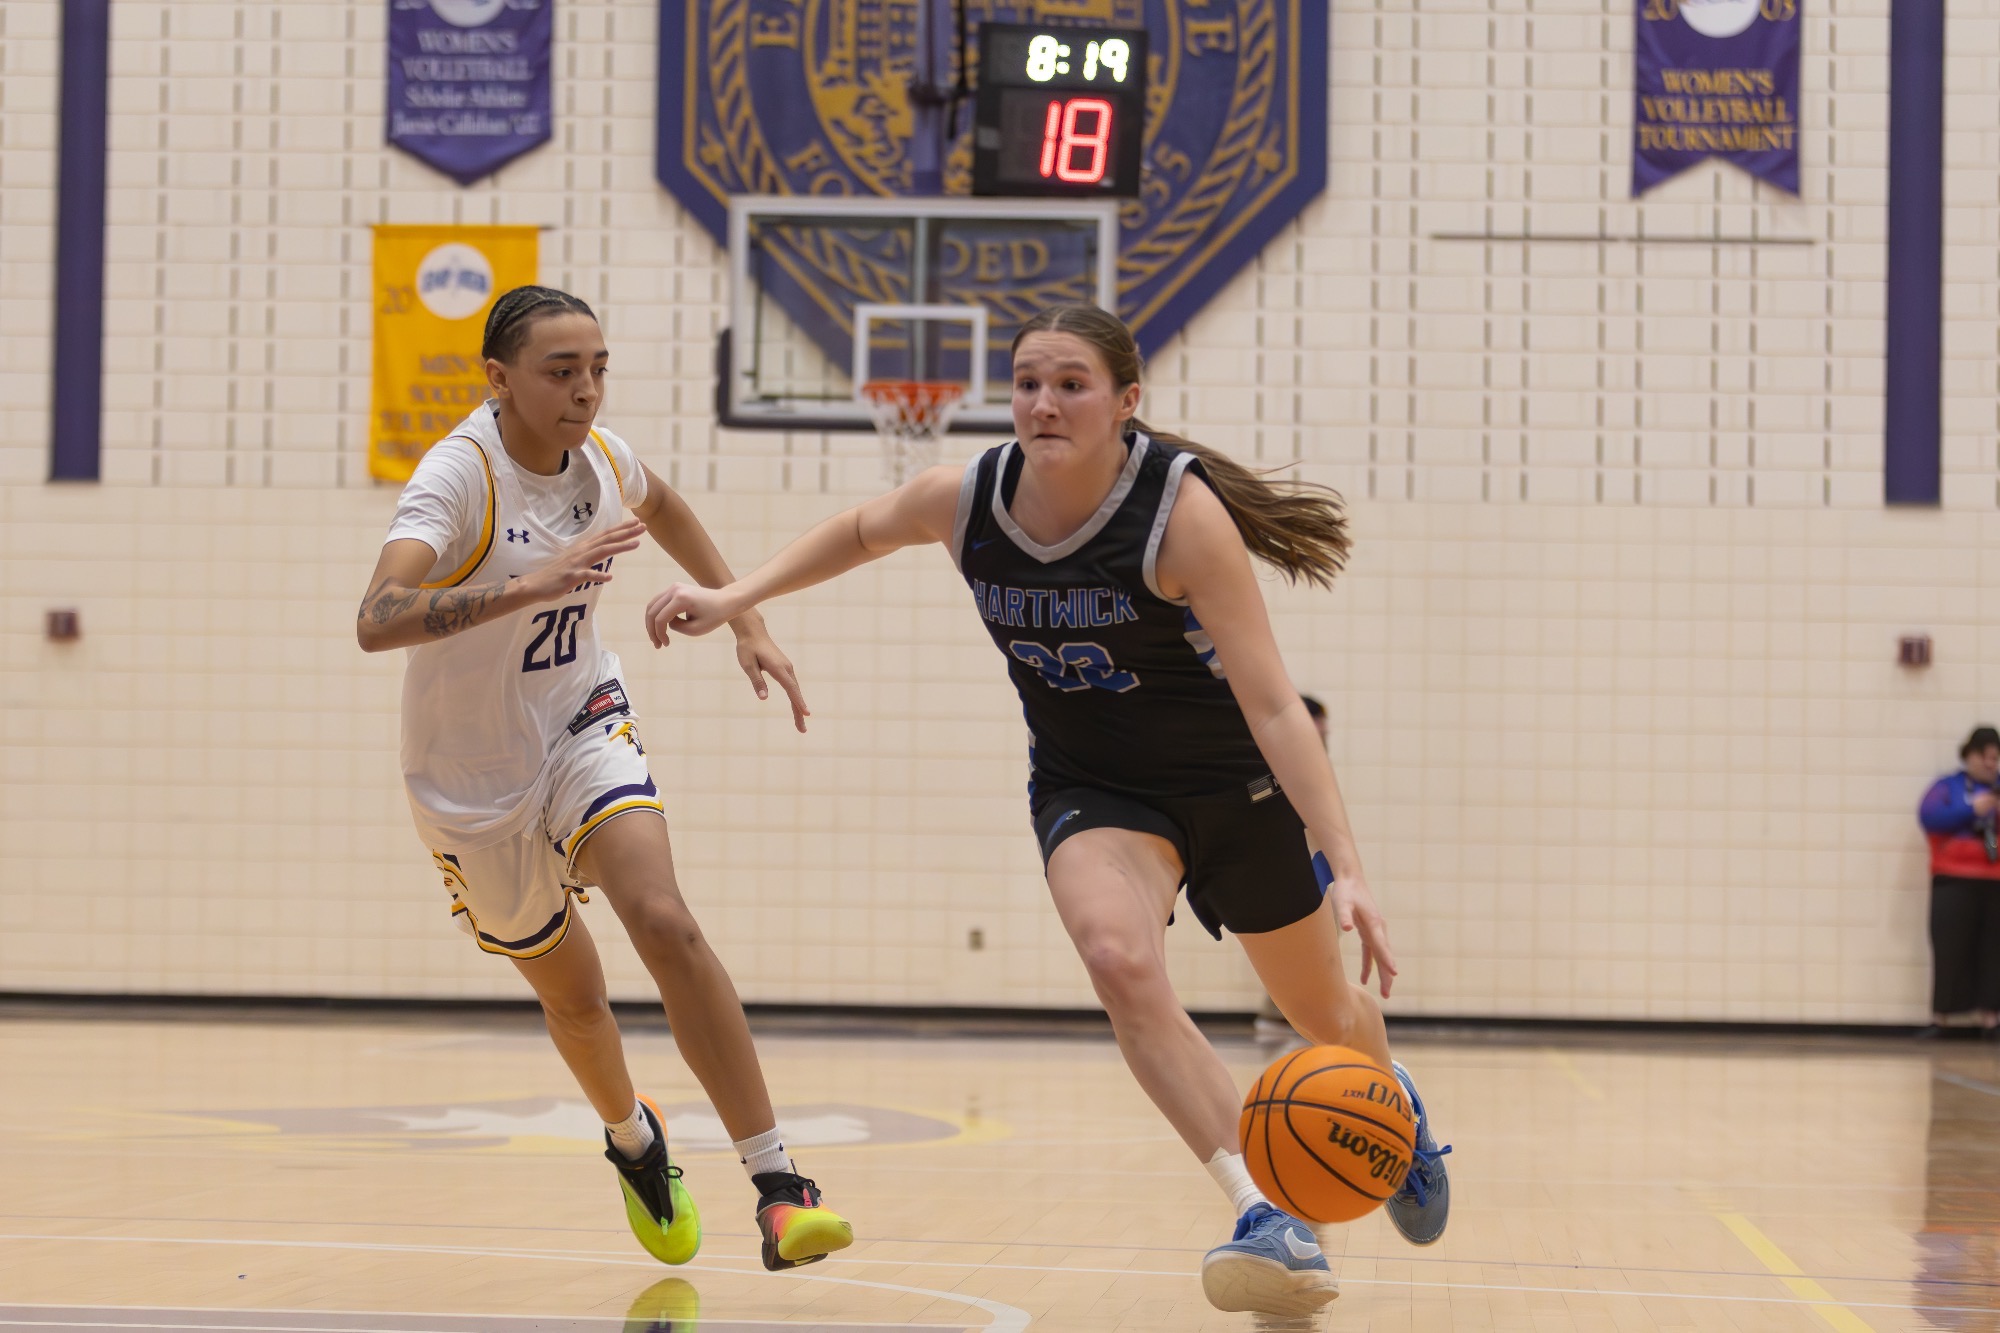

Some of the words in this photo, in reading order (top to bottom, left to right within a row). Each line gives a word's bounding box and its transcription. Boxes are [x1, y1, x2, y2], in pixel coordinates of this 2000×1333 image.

[417, 30, 519, 54] WOMEN'S
[402, 56, 535, 81] VOLLEYBALL
[1026, 34, 1130, 83] 8:19
[1661, 69, 1774, 94] WOMEN'S
[1642, 96, 1792, 123] VOLLEYBALL
[1040, 97, 1112, 183] 18
[1639, 123, 1796, 150] TOURNAMENT
[973, 578, 1140, 629] HARTWICK
[521, 603, 588, 673] 20
